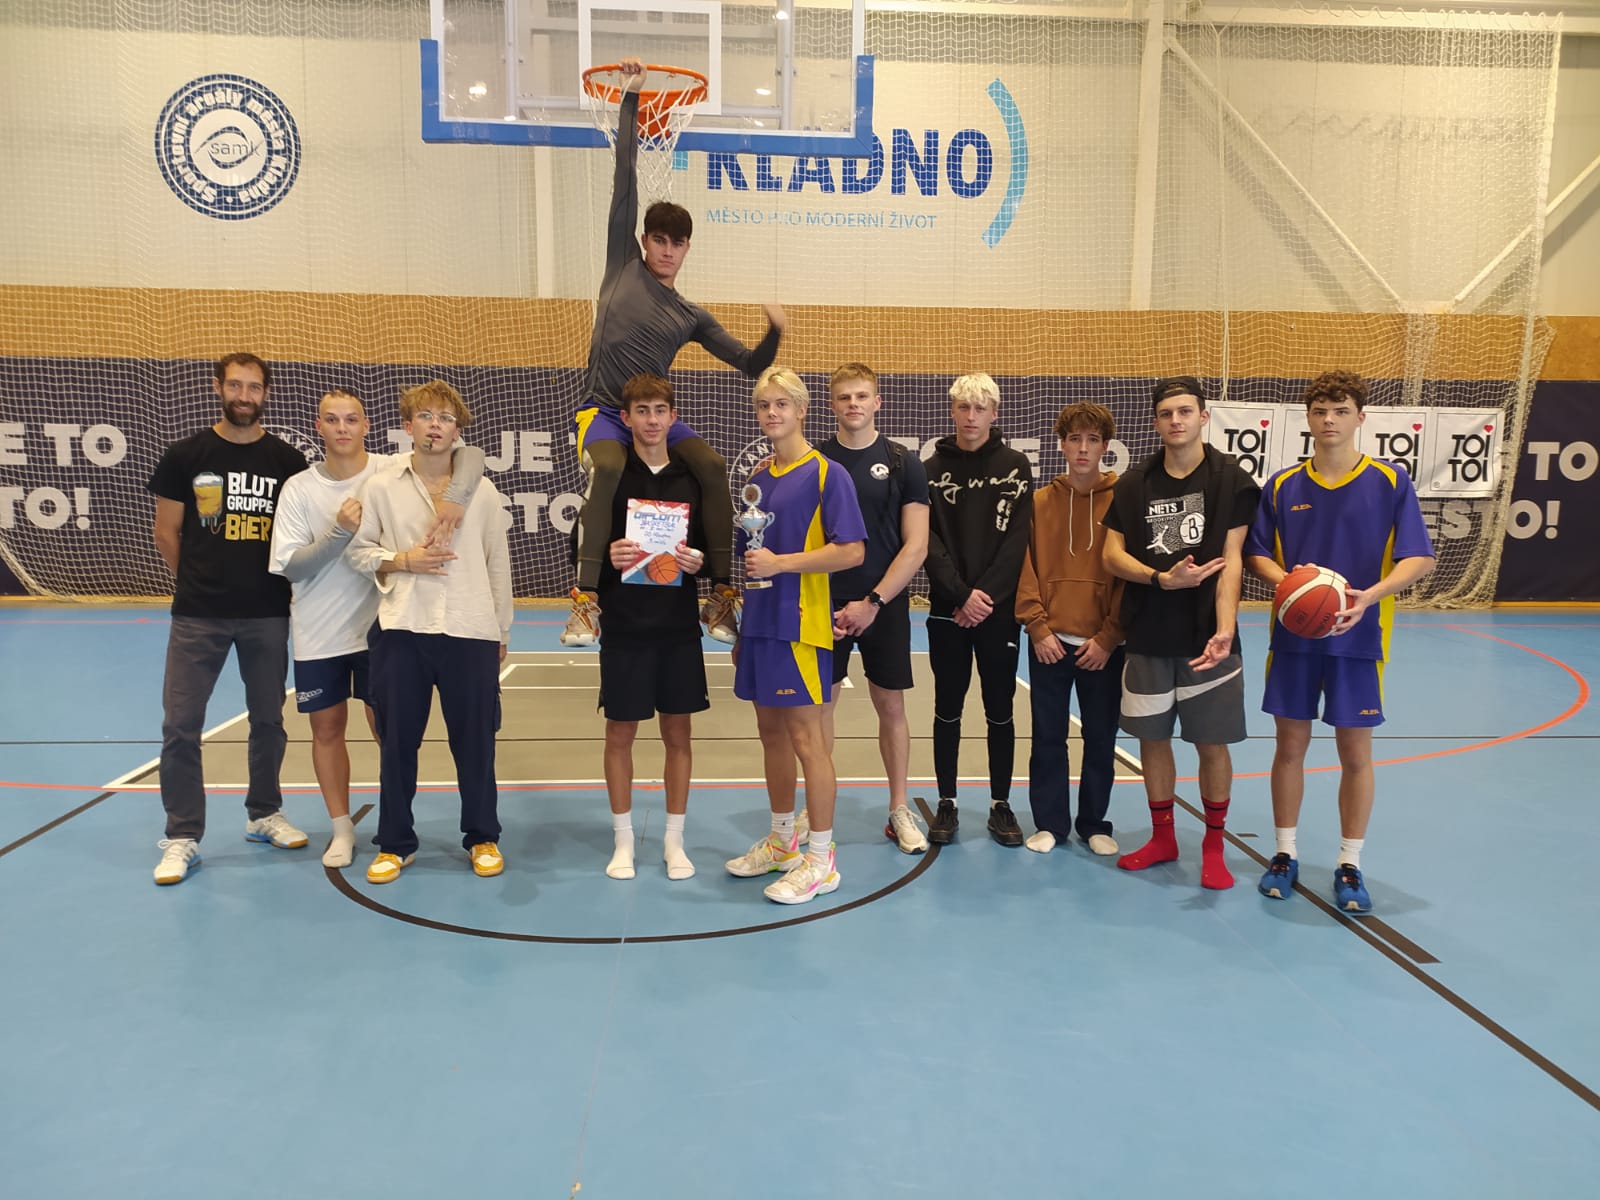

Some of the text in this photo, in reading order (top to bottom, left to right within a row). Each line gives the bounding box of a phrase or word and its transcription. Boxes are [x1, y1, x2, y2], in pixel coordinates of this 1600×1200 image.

[706, 128, 993, 199] KLADNO
[706, 206, 763, 225] MĚSTO
[806, 209, 885, 228] MODERNÍ
[889, 209, 937, 230] ŽIVOT
[44, 423, 127, 468] TO
[1447, 458, 1488, 483] TOI
[1528, 441, 1599, 481] TO
[227, 472, 277, 498] BLUT
[226, 496, 274, 513] GRUPPE
[1149, 502, 1178, 515] NETS
